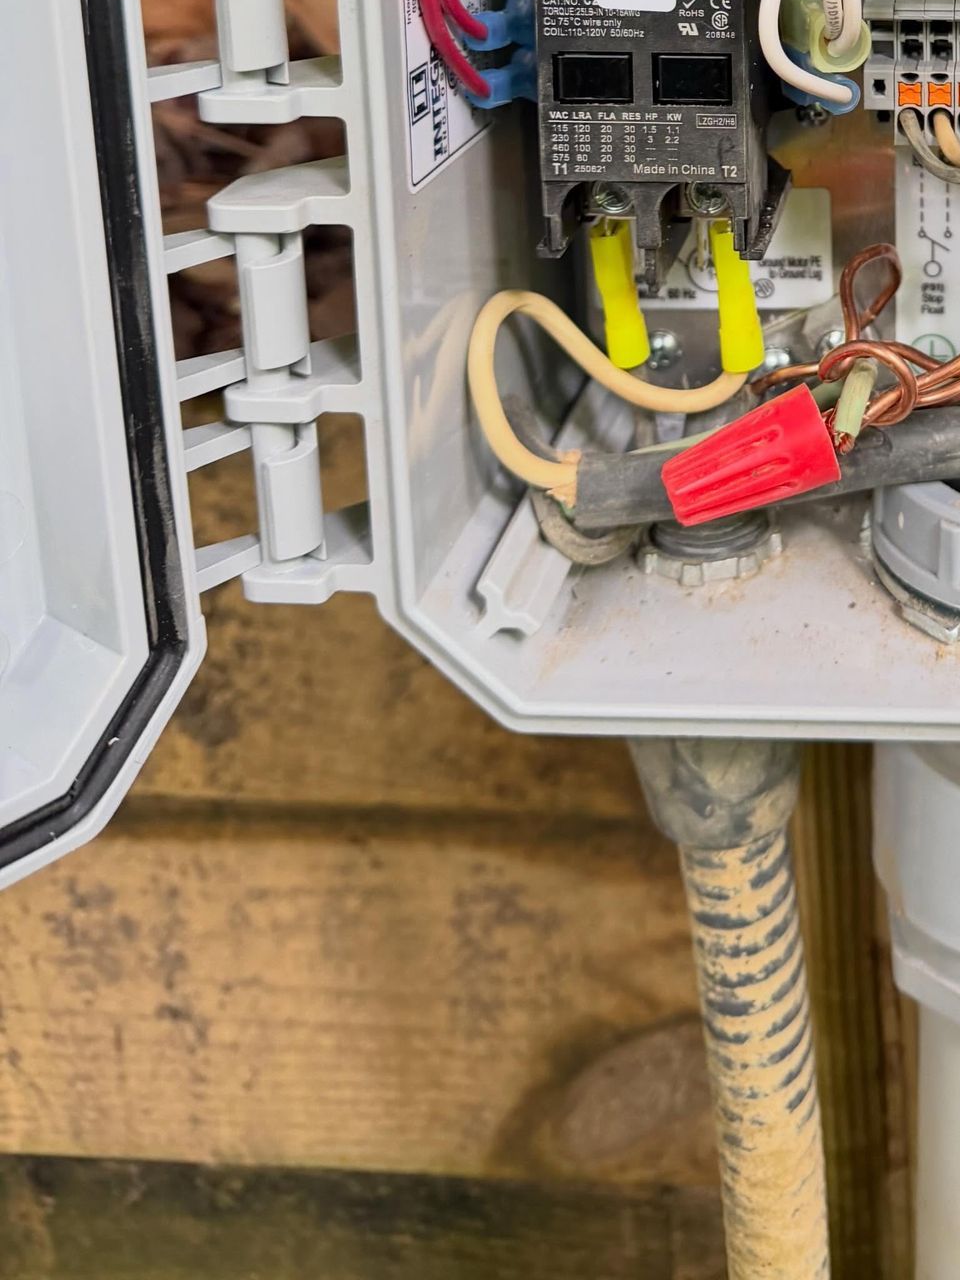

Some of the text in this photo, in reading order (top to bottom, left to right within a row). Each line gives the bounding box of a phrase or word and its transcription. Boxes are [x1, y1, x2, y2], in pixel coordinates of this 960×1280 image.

[678, 9, 705, 17] RoHS
[543, 16, 622, 29] Cu 75°C wire only
[543, 27, 645, 38] COIL:110-120V 50/60Hz
[430, 44, 443, 161] INTEGR
[549, 111, 682, 122] VAC LRA FLA RES HP KW
[552, 124, 680, 134] 115 120 20 30 1.5 1.1
[552, 134, 570, 142] 230
[600, 135, 613, 143] 20
[624, 135, 636, 143] 30
[647, 136, 654, 144] 3
[665, 136, 680, 144] 2.2
[600, 145, 613, 153] 20
[624, 145, 636, 153] 30
[552, 154, 570, 162] 575
[600, 154, 613, 162] 20
[624, 155, 636, 163] 30
[552, 163, 568, 175] T1
[633, 164, 715, 175] Made in China
[722, 166, 738, 178] T2
[921, 293, 944, 304] Stop
[921, 304, 945, 314] Float
